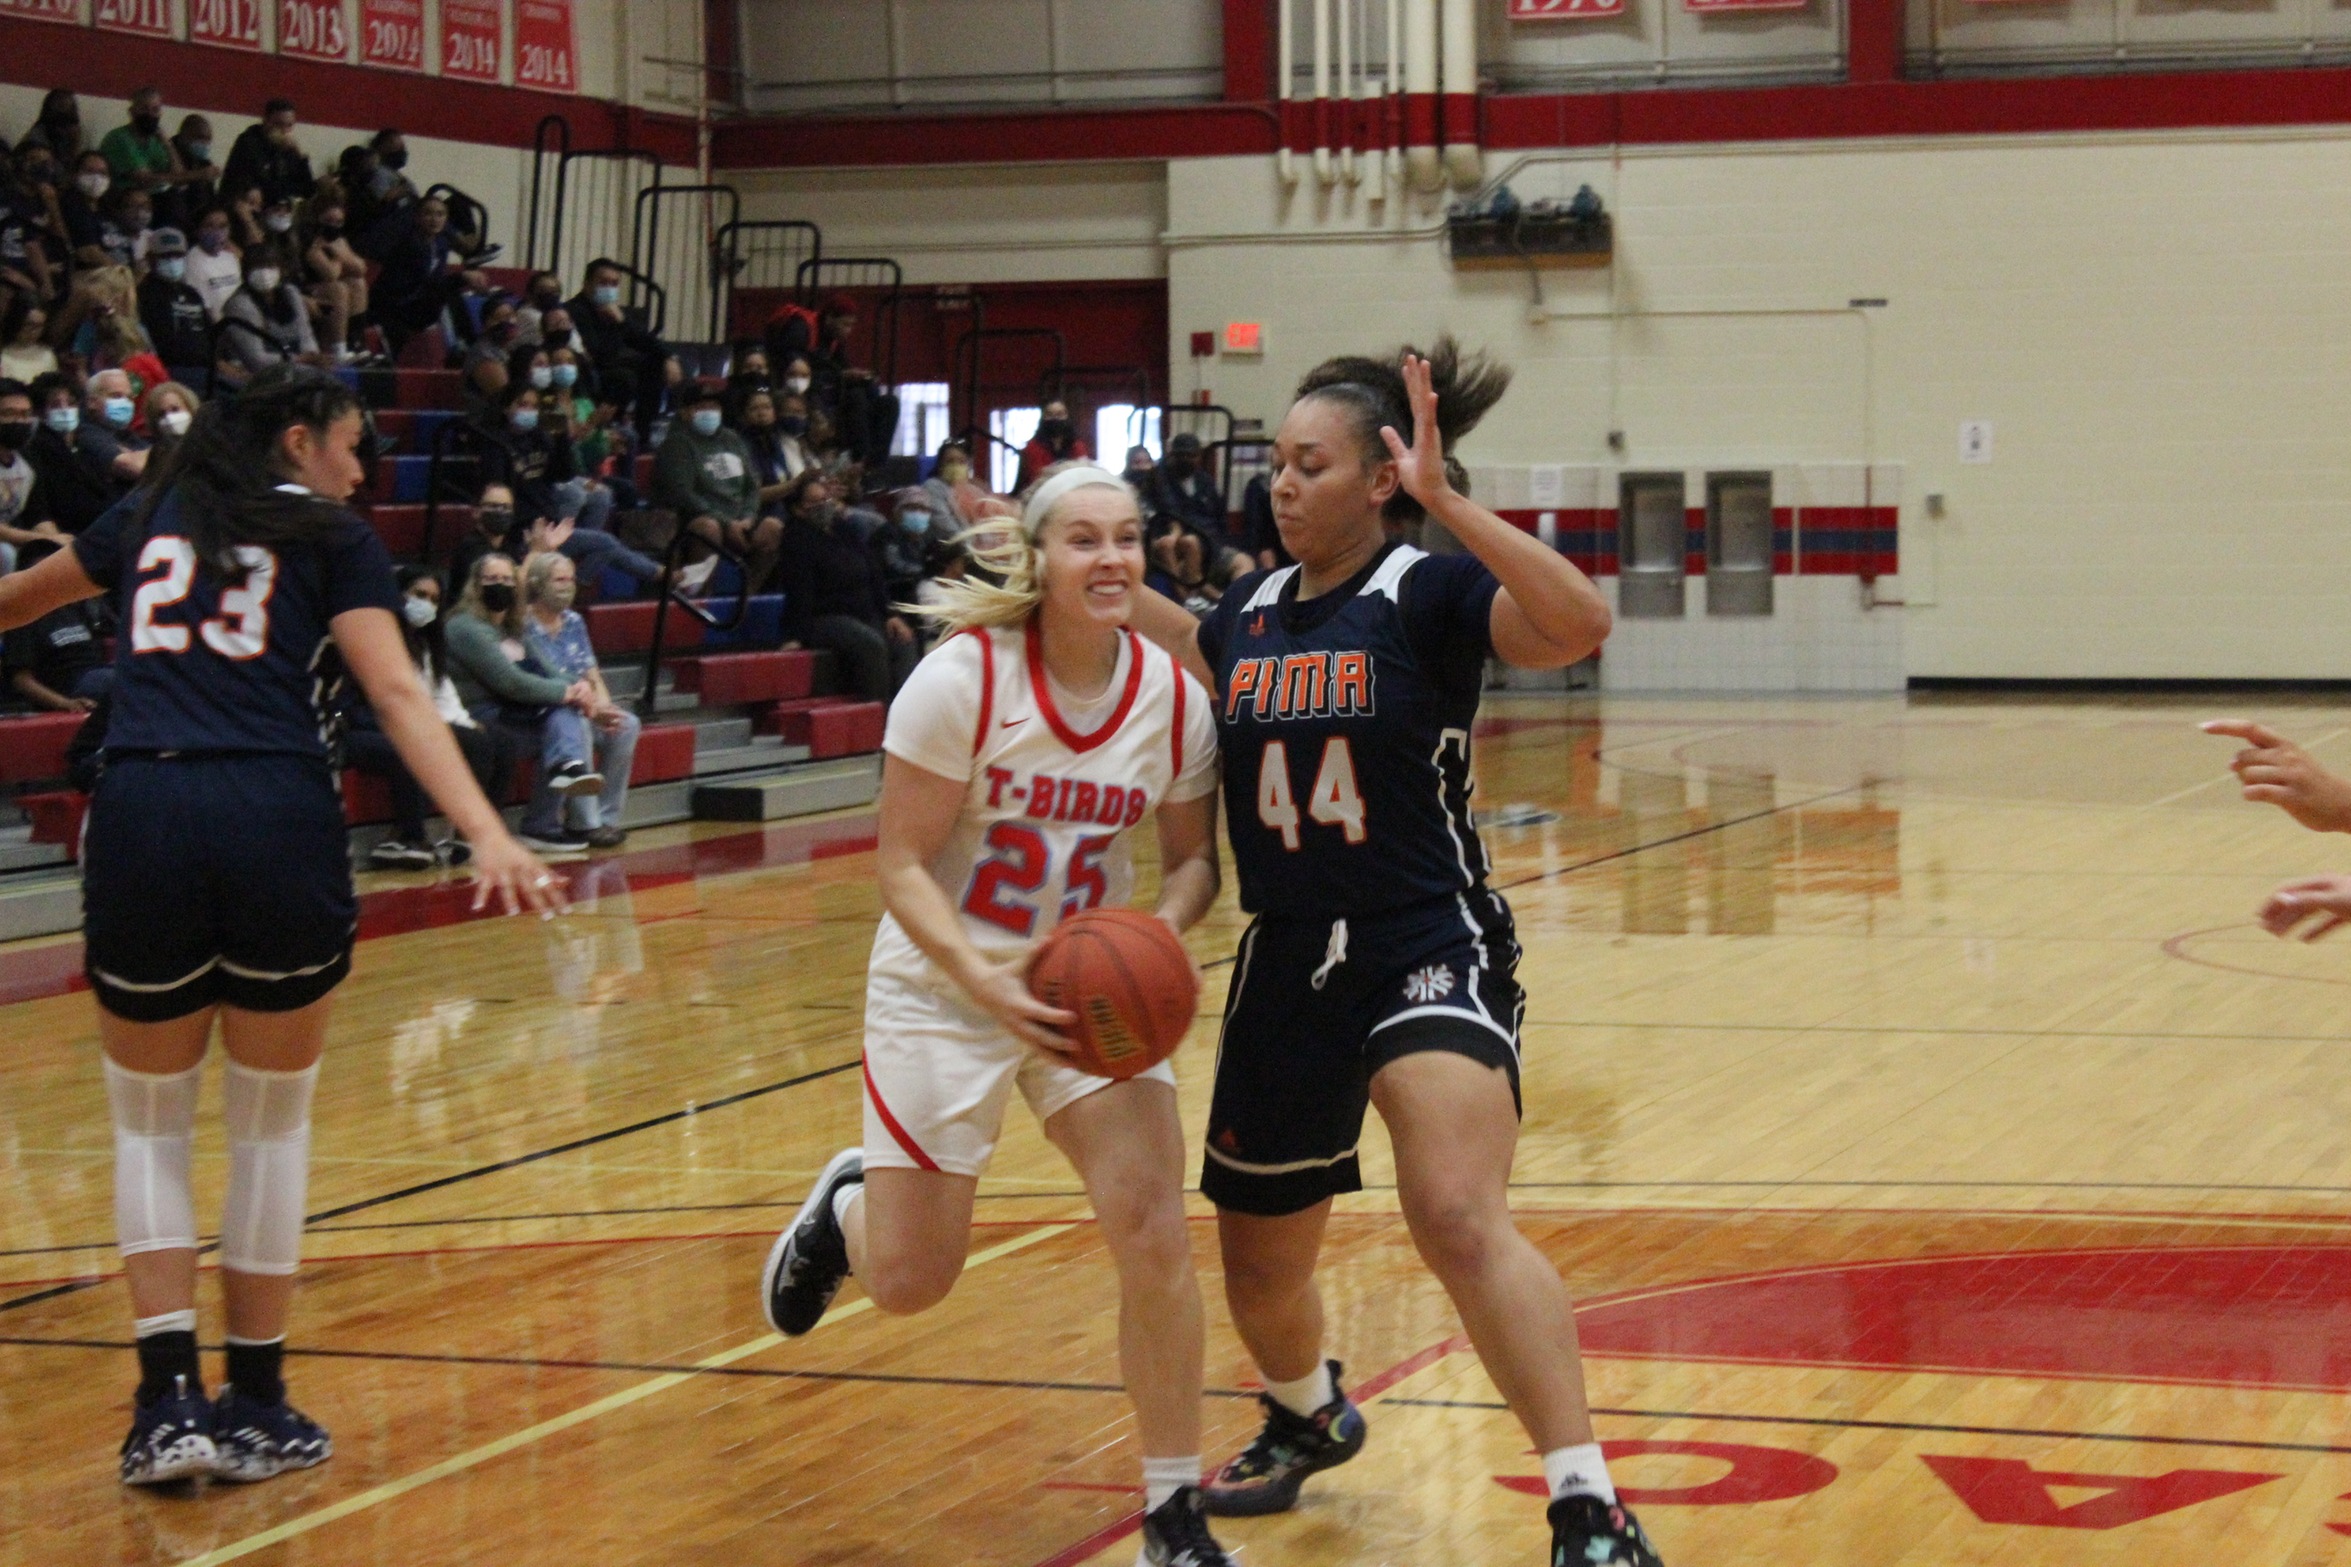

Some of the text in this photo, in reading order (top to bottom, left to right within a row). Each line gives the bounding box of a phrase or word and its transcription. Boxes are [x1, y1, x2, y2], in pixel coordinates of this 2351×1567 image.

[194, 0, 259, 40] 2012
[283, 0, 346, 55] 2013
[368, 20, 421, 62] 2014
[448, 32, 496, 74] 2014
[519, 43, 569, 85] 2014
[132, 535, 279, 661] 23
[1225, 651, 1376, 724] PIMA
[985, 765, 1147, 828] T-BIRDS
[1257, 736, 1367, 852] 44
[961, 820, 1114, 938] 25
